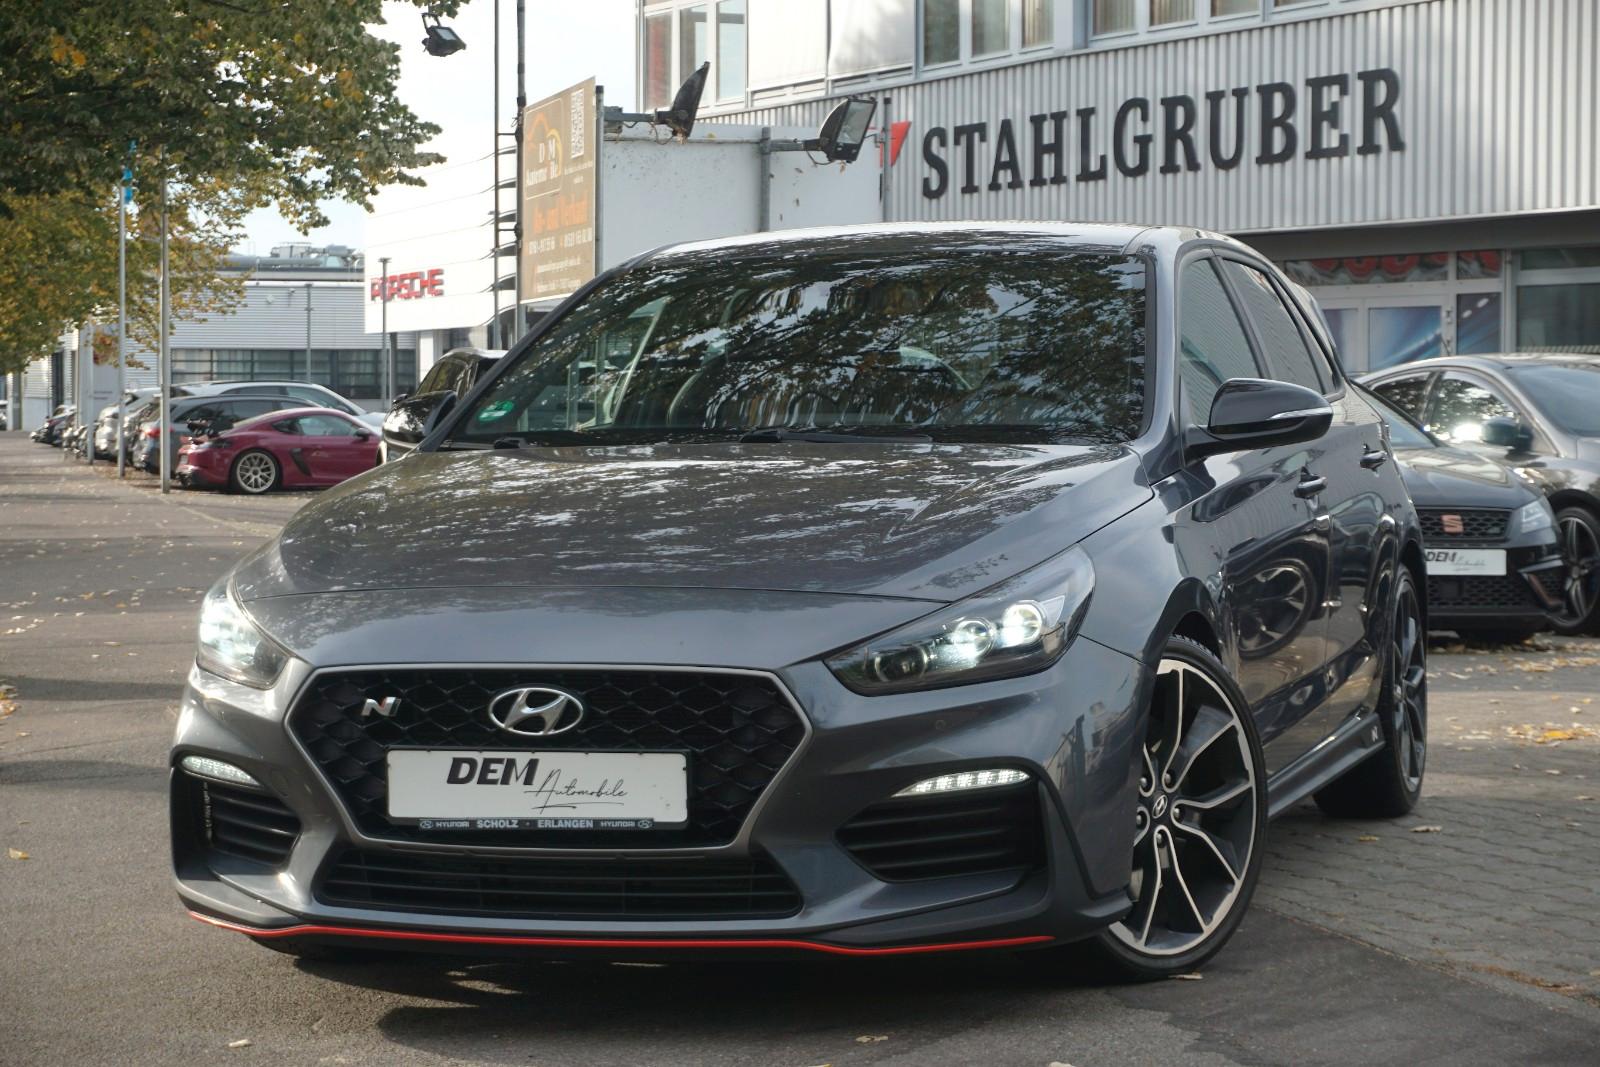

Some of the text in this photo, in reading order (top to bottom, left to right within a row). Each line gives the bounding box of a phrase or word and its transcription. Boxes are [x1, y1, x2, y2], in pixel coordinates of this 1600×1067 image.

[922, 68, 1406, 199] STAHLGRUBER
[446, 757, 629, 806] DEM Automobile
[436, 819, 636, 829] HYUNDAI SCHOLZ ERLANGEN HYUNDAI
